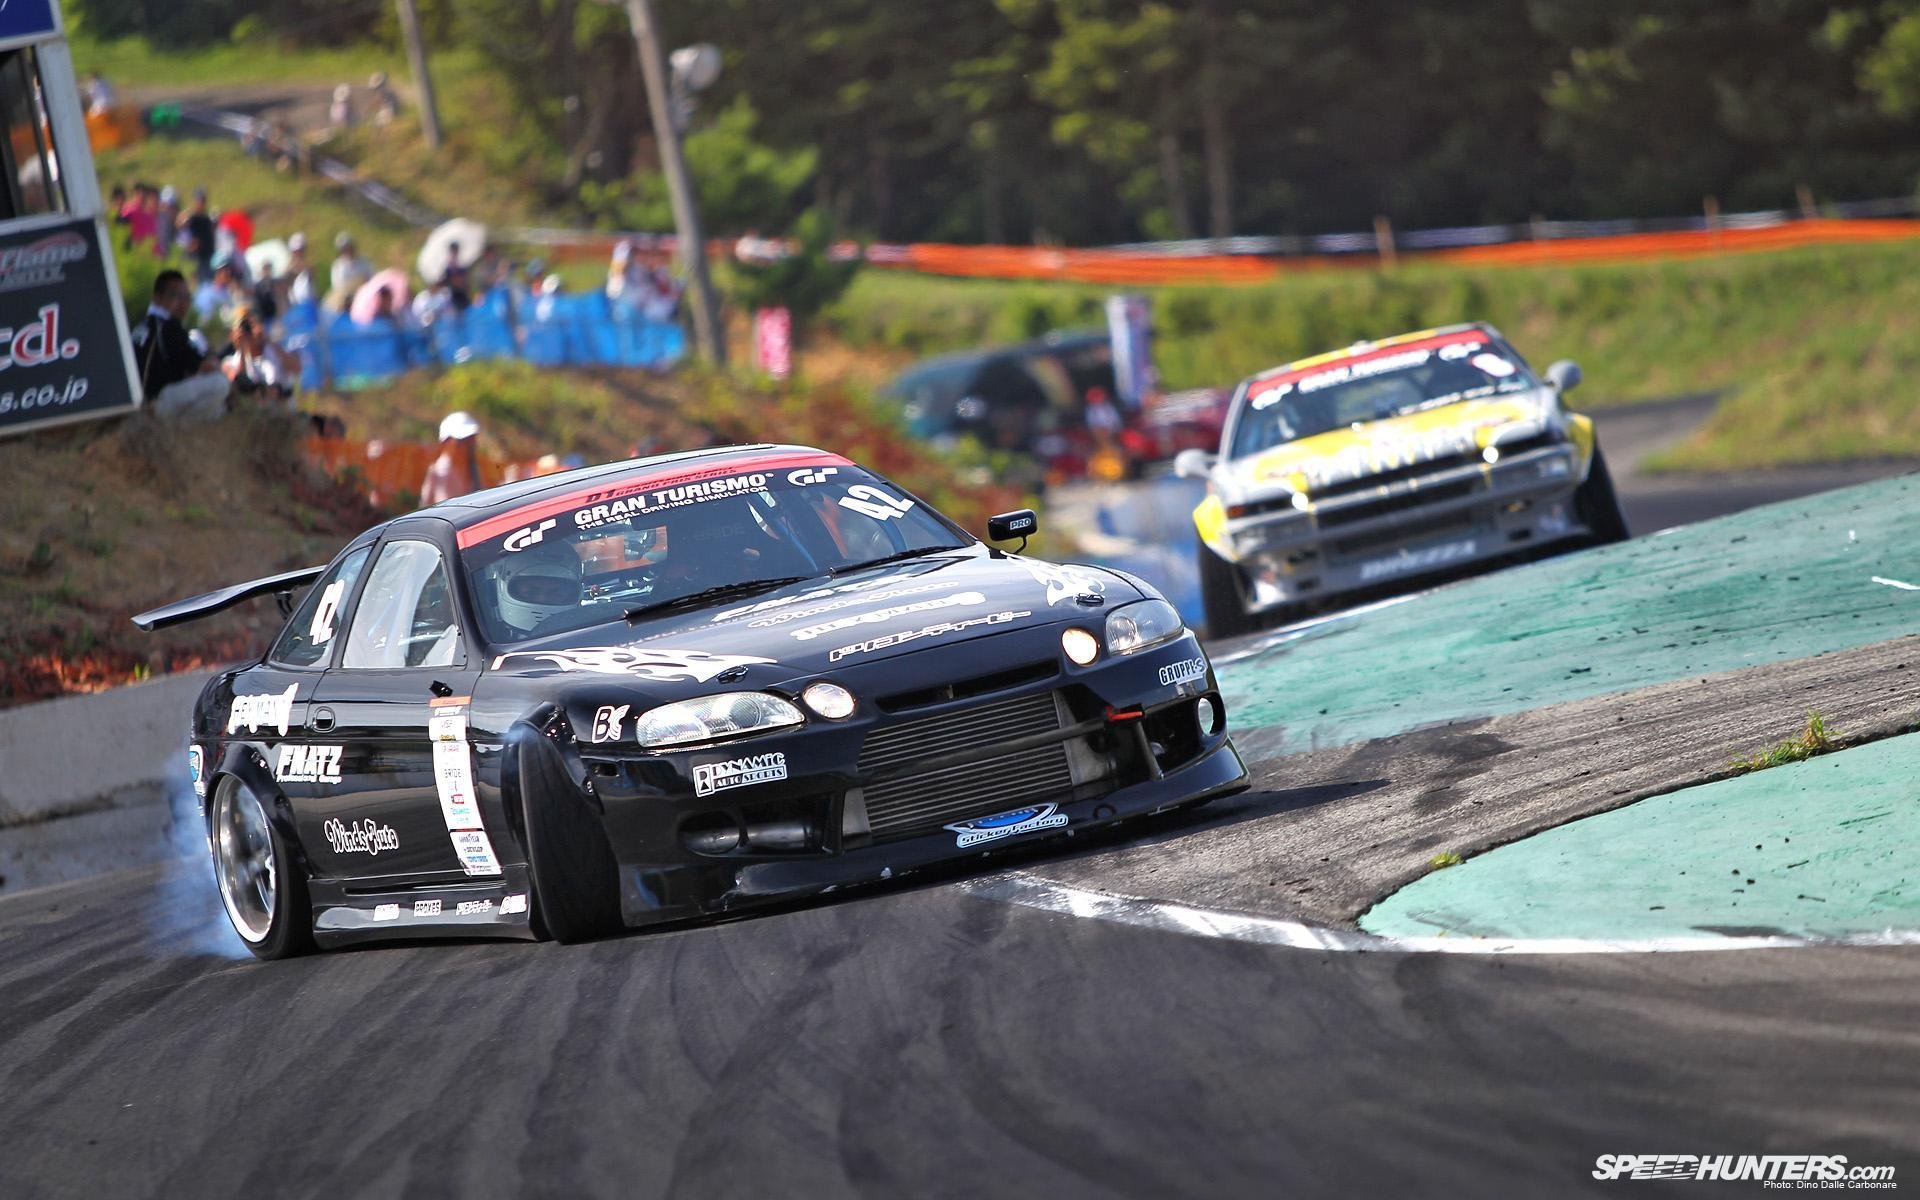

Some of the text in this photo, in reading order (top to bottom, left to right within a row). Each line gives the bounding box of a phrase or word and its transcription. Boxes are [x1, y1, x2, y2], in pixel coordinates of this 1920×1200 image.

[574, 495, 646, 526] GRAN
[655, 474, 768, 505] TURISMO
[577, 486, 769, 531] THE REAL DRIVING SIMULATOR
[838, 484, 915, 521] 42
[1010, 518, 1031, 529] PRO
